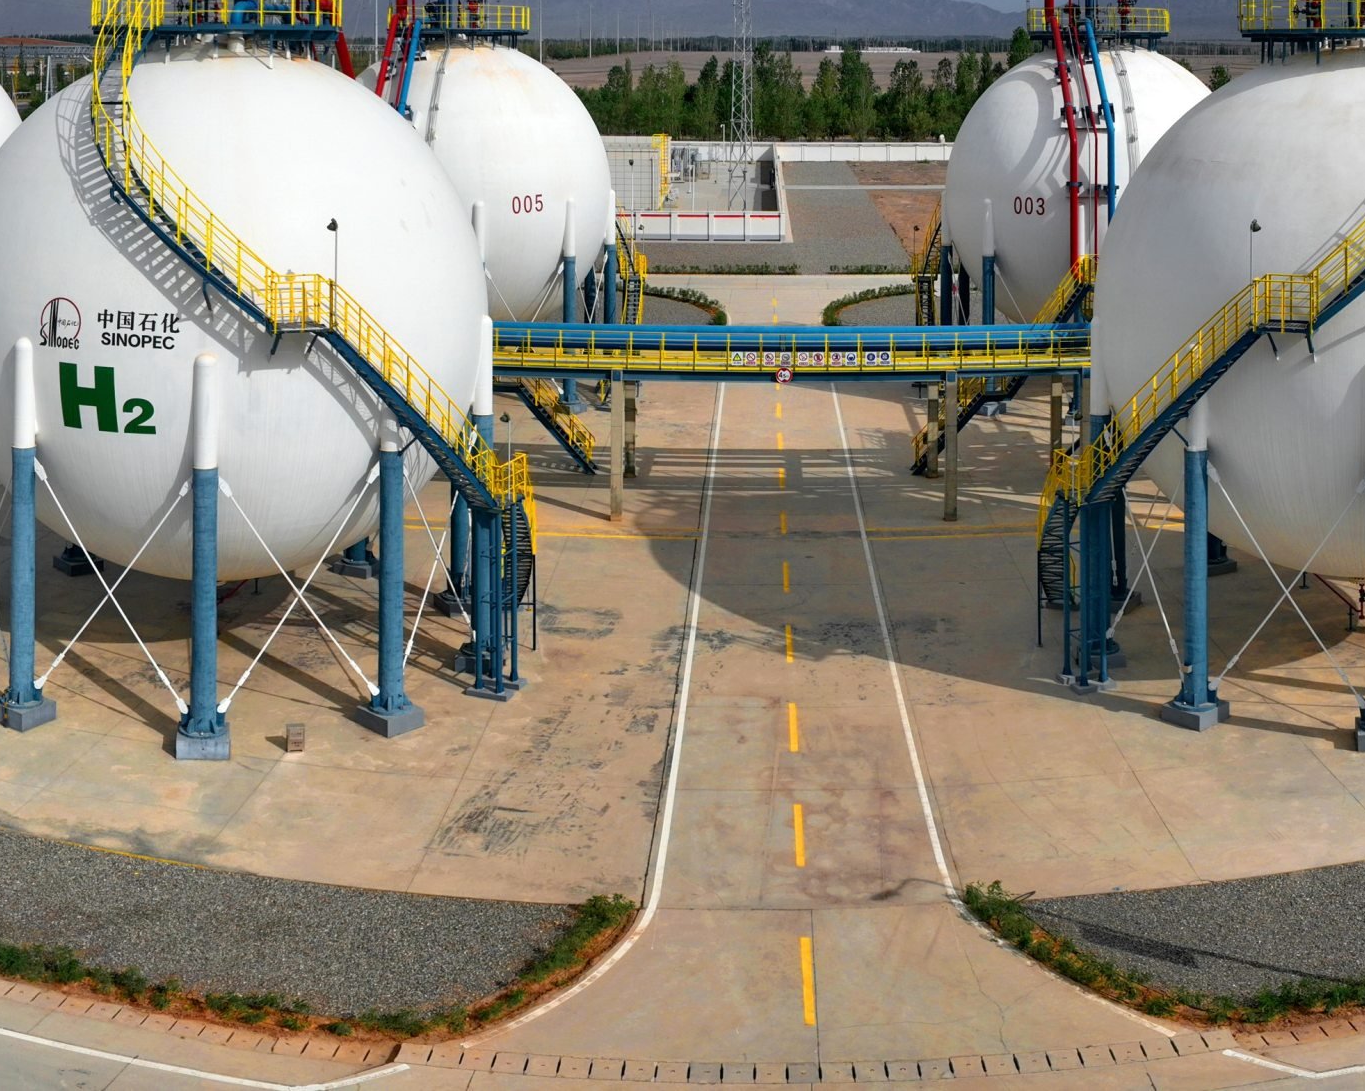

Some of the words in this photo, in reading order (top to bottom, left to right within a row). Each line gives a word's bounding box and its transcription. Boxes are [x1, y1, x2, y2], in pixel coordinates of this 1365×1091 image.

[512, 194, 544, 214] 005
[1014, 196, 1045, 215] 003
[97, 309, 180, 334] 中国石化
[101, 331, 175, 350] SINOPEC
[59, 362, 156, 435] H2
